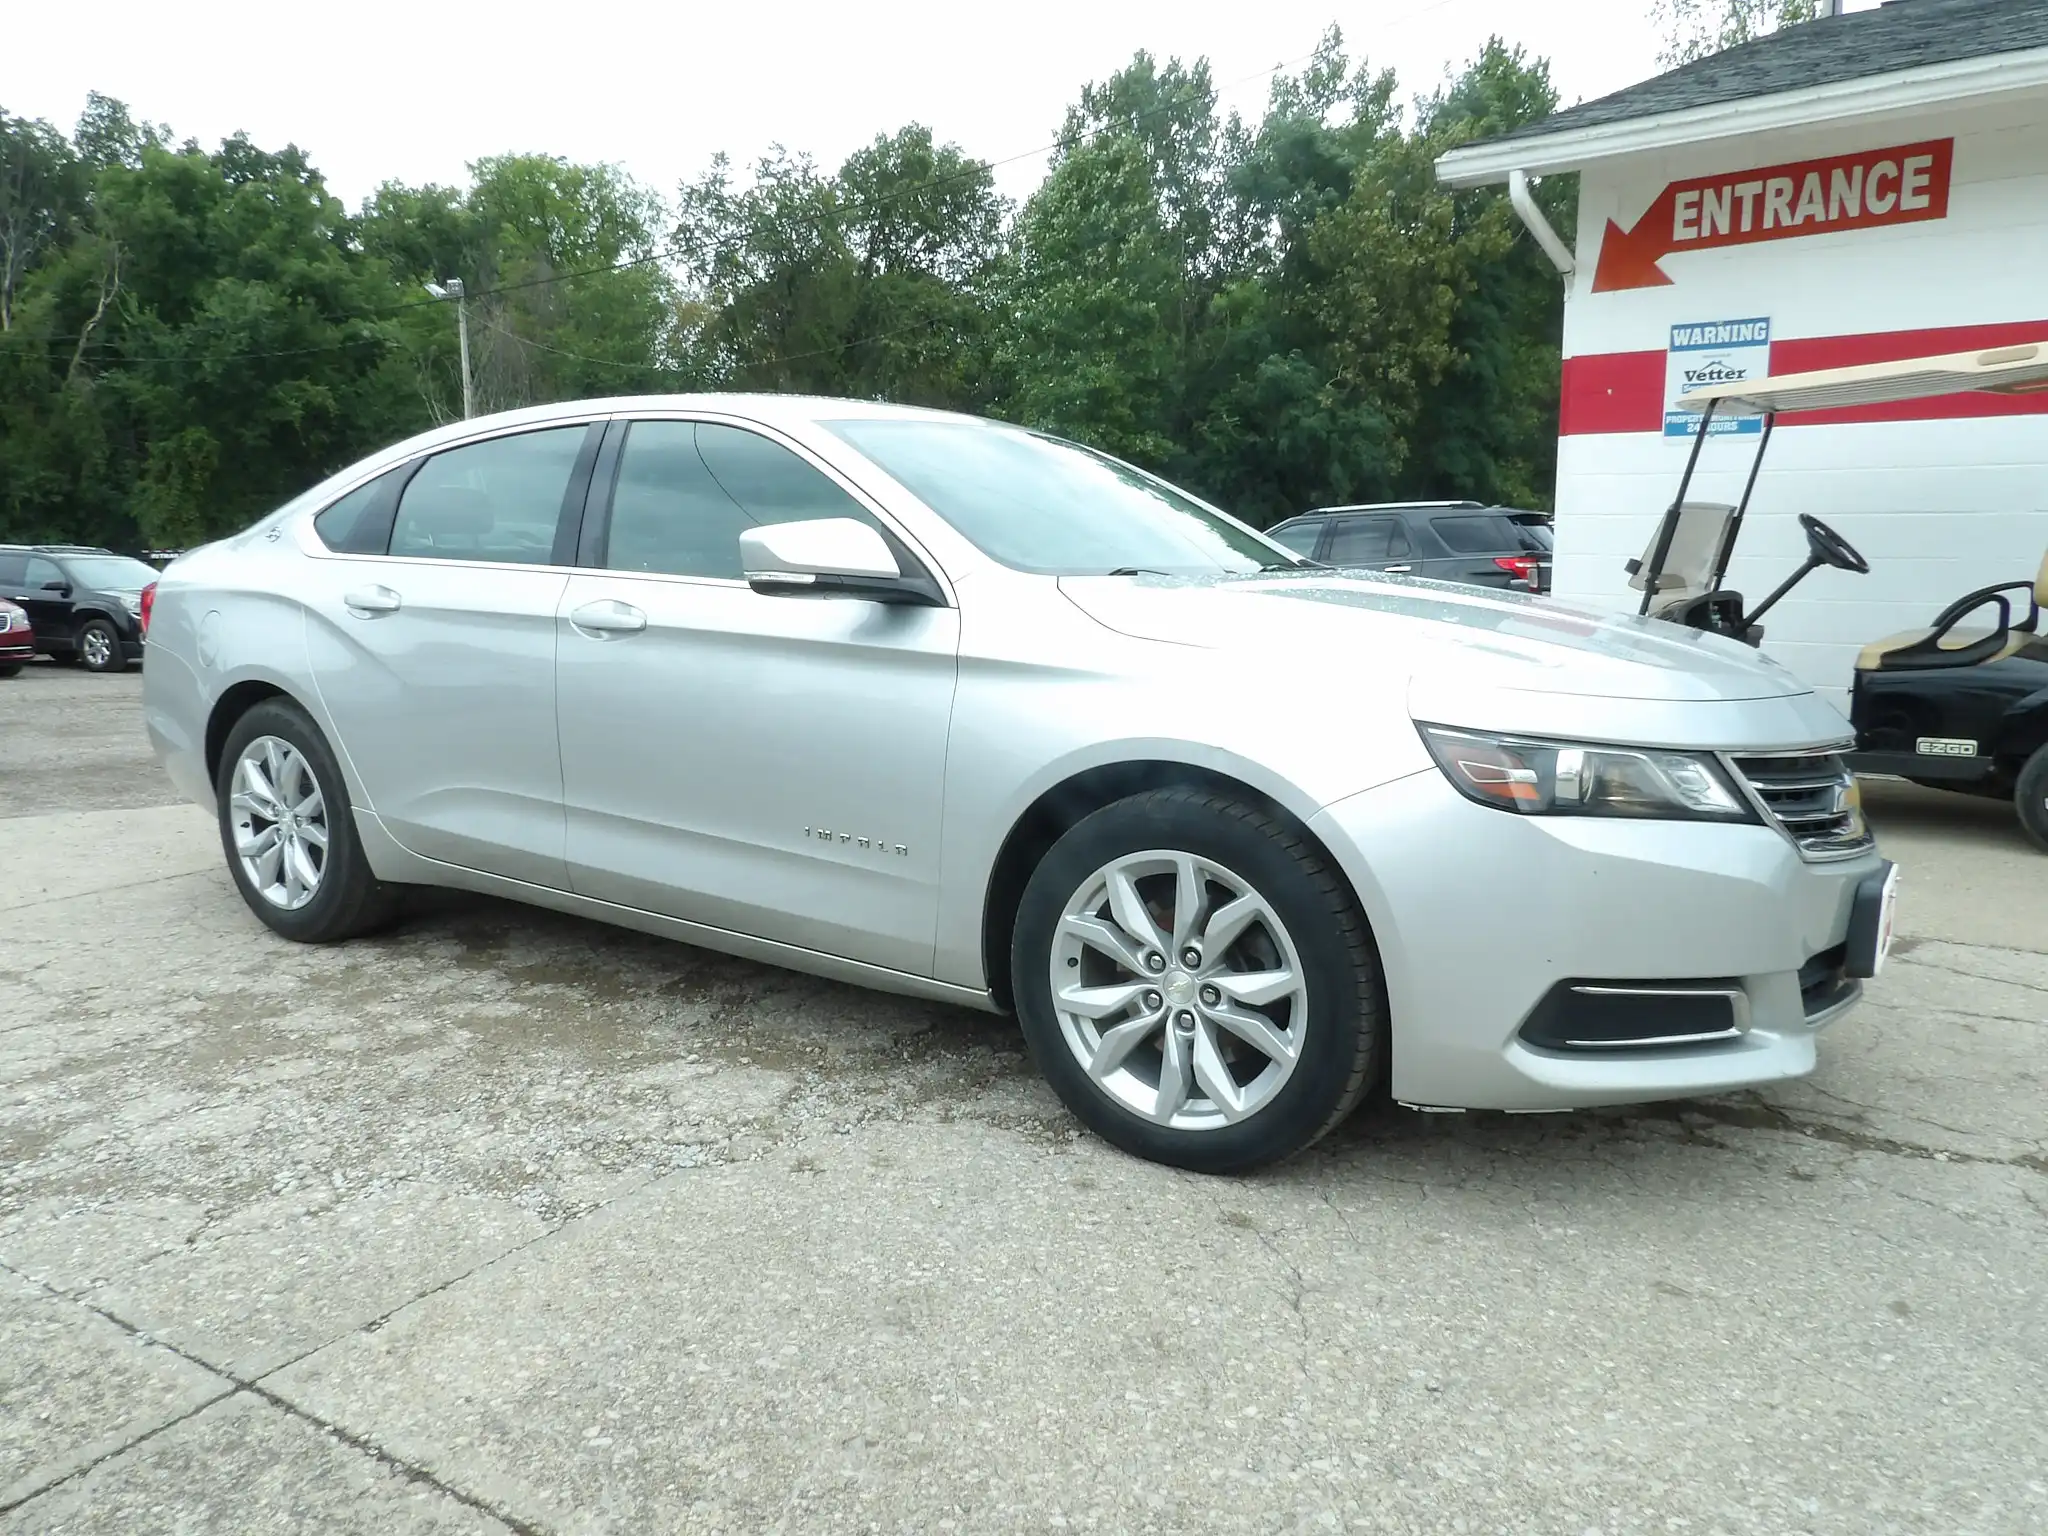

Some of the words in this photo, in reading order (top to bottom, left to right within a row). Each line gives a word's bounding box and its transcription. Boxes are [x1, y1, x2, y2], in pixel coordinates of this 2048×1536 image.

[1673, 154, 1933, 241] ENTRANCE
[1673, 322, 1767, 346] WARNING
[1684, 368, 1747, 382] Vetter
[1686, 423, 1700, 433] 24
[1919, 742, 1974, 754] EZGO
[804, 825, 908, 856] IMPALA
